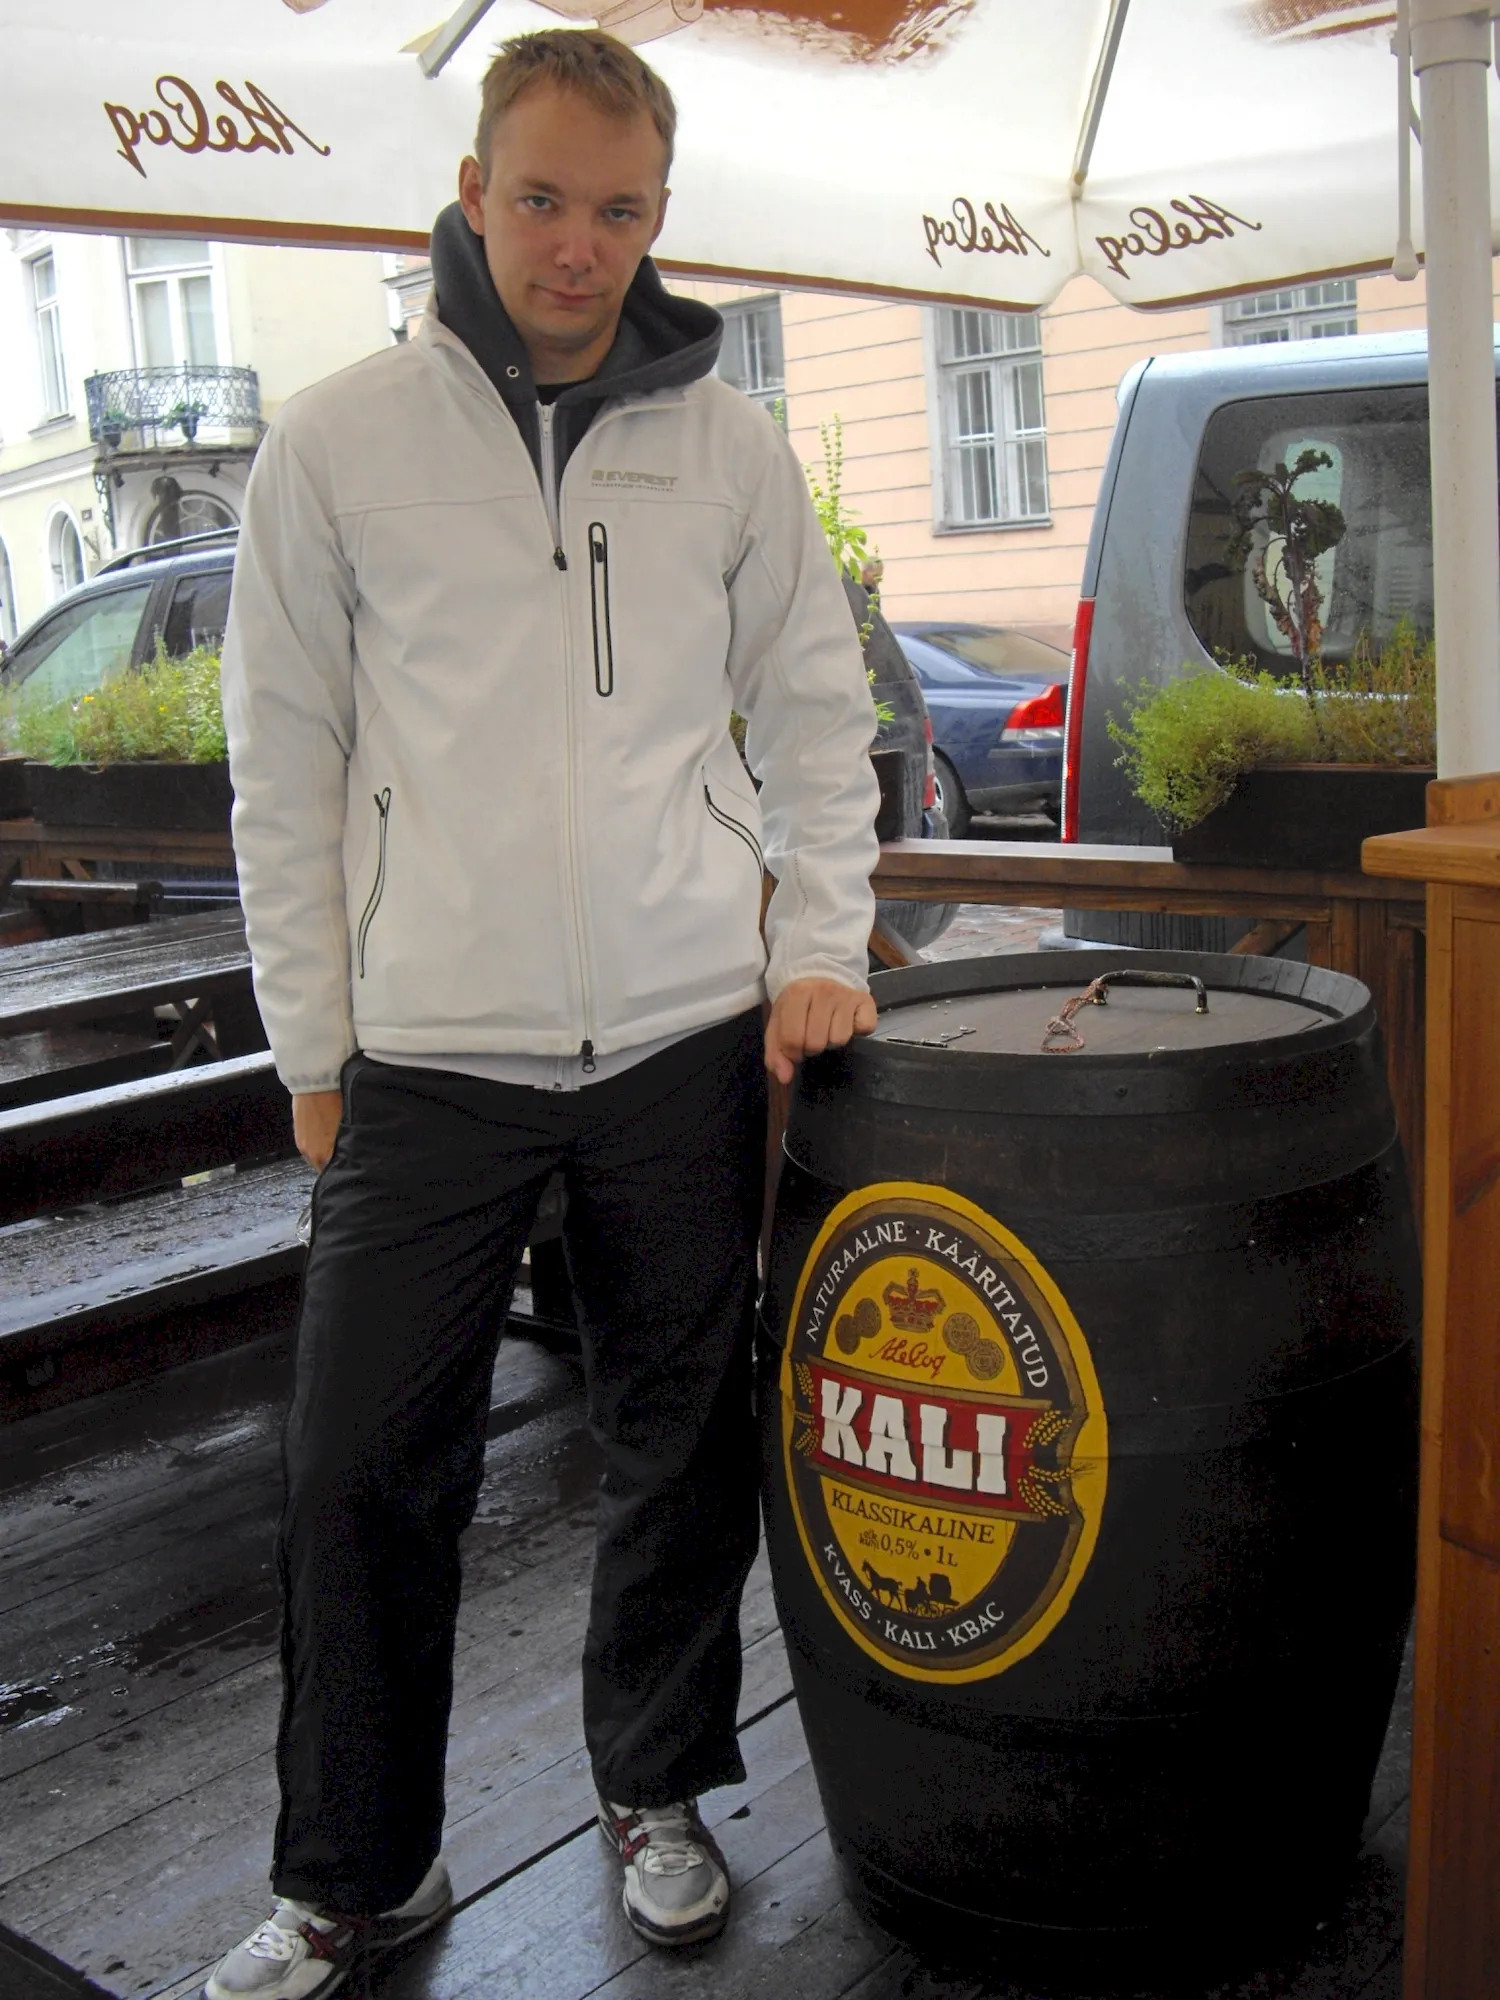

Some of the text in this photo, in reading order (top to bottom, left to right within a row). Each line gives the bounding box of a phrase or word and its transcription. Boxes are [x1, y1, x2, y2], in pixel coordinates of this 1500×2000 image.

[606, 470, 679, 487] EVEREST
[805, 1220, 1050, 1390] NATURAALNE KÄÄRITATUD
[820, 1378, 1007, 1495] KALI
[831, 1488, 995, 1544] KLASSIKALINE
[881, 1533, 920, 1560] 0,5%
[824, 1543, 872, 1620] KVASS
[884, 1619, 937, 1650] KALI
